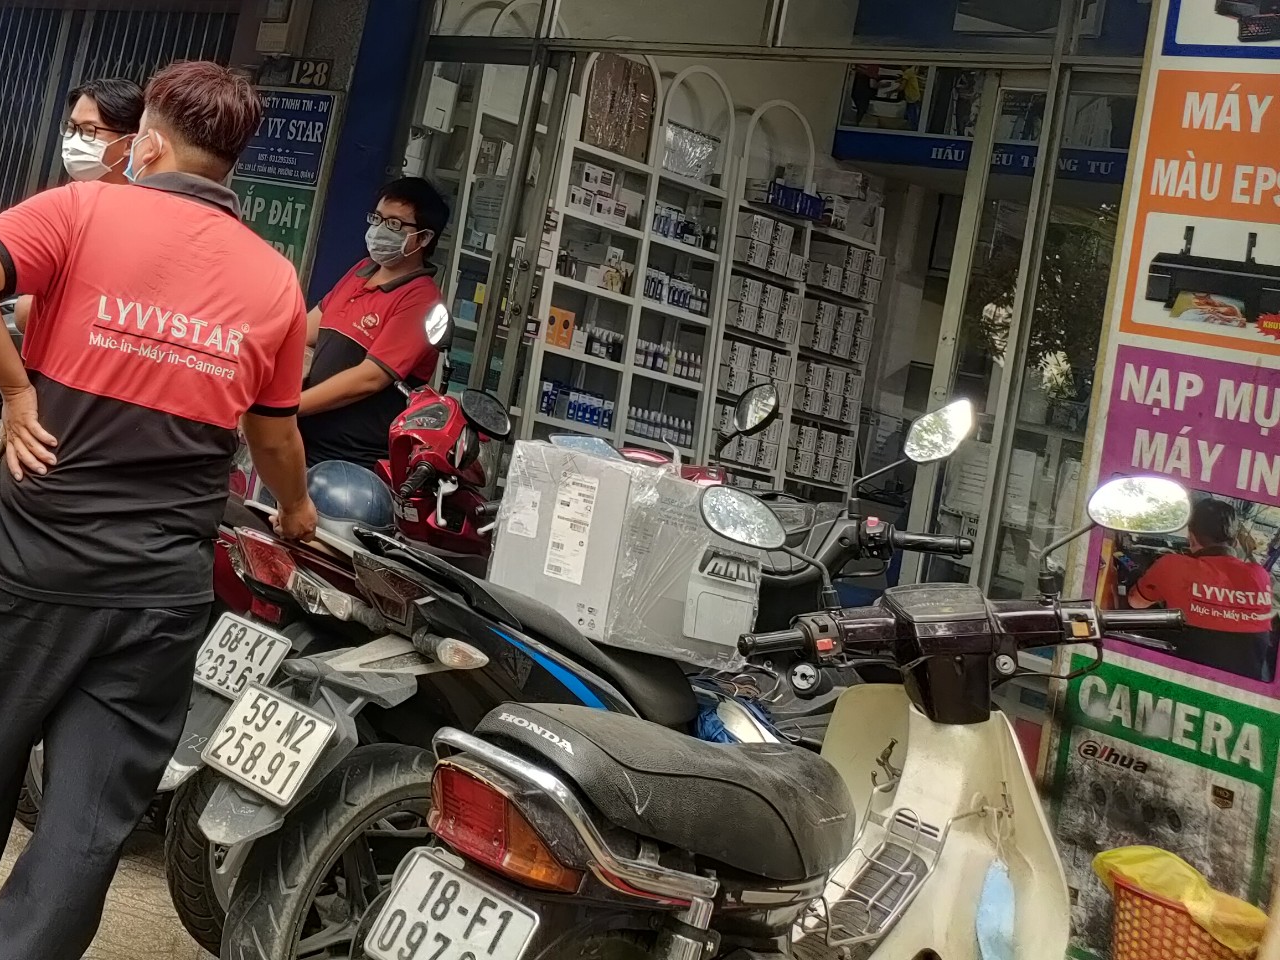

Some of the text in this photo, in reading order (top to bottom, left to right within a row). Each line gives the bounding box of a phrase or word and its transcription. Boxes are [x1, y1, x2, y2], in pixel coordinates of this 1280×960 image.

[289, 60, 329, 87] 128
[267, 117, 287, 139] VY
[287, 119, 324, 143] STAR
[281, 98, 301, 111] TNHH
[302, 100, 314, 112] TM
[1181, 83, 1274, 133] MÁY
[1150, 150, 1222, 202] MÀU
[239, 185, 306, 235] ẮP ĐẶT
[97, 295, 244, 356] LYVYSTAR
[1120, 362, 1203, 416] NẠP
[1131, 425, 1280, 497] MÁY IN
[498, 712, 575, 756] HONDA
[1078, 674, 1264, 773] CAMERA
[210, 726, 301, 795] 258.91
[417, 871, 513, 955] 18-F1
